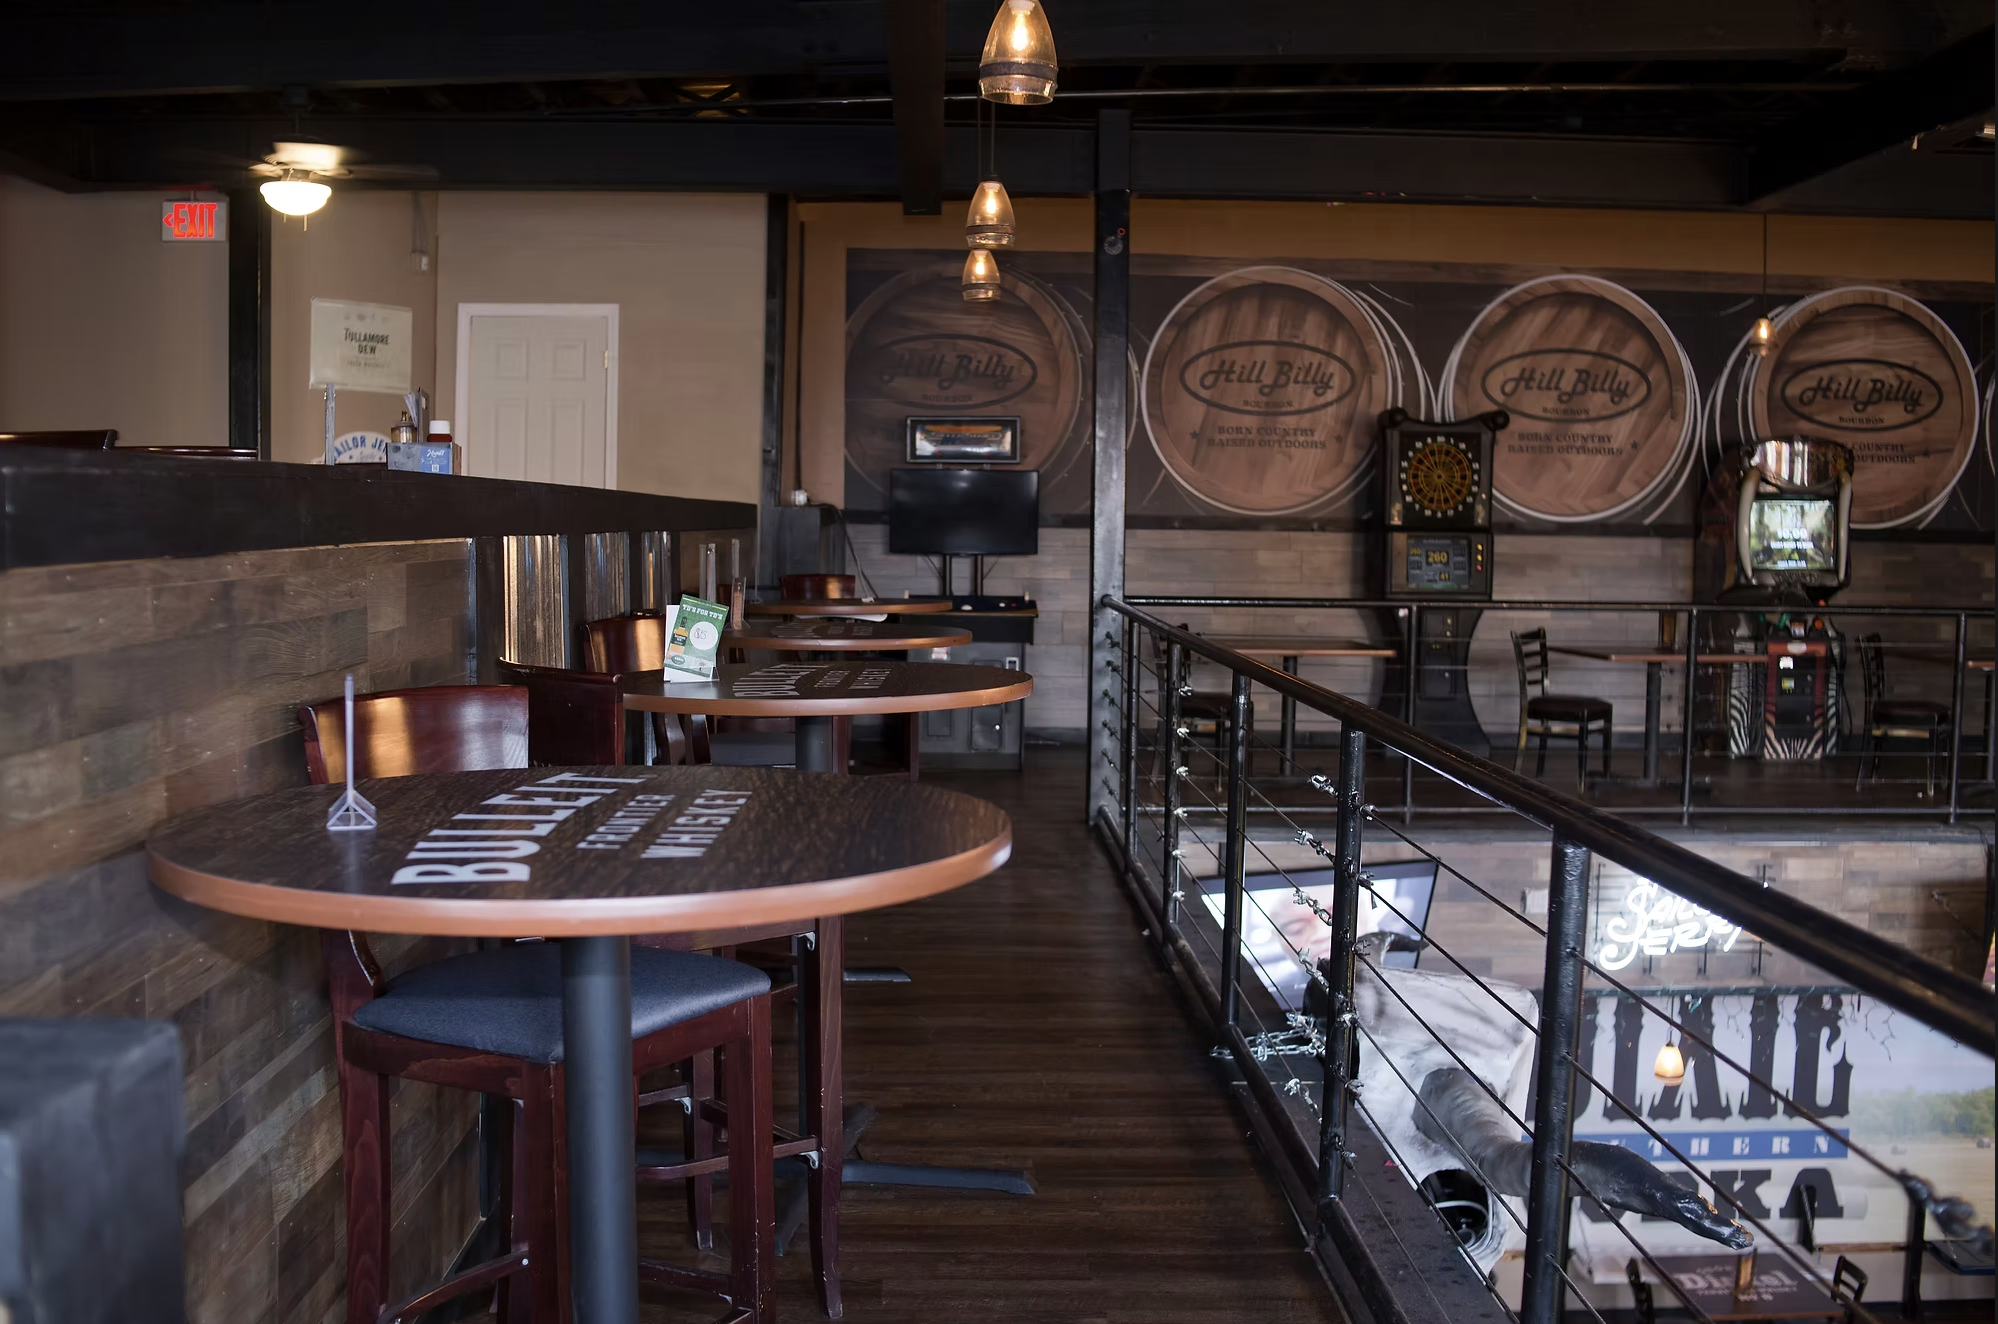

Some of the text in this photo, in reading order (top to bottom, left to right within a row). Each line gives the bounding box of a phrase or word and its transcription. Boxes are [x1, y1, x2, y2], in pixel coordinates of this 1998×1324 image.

[173, 202, 218, 238] EXIT
[343, 327, 390, 345] TULLAMORE
[357, 344, 377, 355] DEW
[938, 353, 1017, 391] Billy
[1200, 359, 1334, 397] Hill Billy
[1501, 367, 1630, 406] Hill Billy
[1800, 375, 1923, 415] Hill Billy
[1242, 400, 1294, 408] BOURBON
[1542, 407, 1590, 416] BOURBON
[1839, 416, 1885, 425] BOURBON
[1217, 426, 1317, 437] BORN COUNTRY
[1518, 432, 1613, 444] BORN COUNTRY
[335, 435, 366, 460] AILOR
[1207, 438, 1328, 448] RAISED OUTDOORS
[1507, 444, 1623, 456] RAISED OUTDOORS
[390, 772, 648, 886] BULLEIT
[576, 794, 676, 850] FRONTIER
[639, 788, 753, 859] WHISKEY
